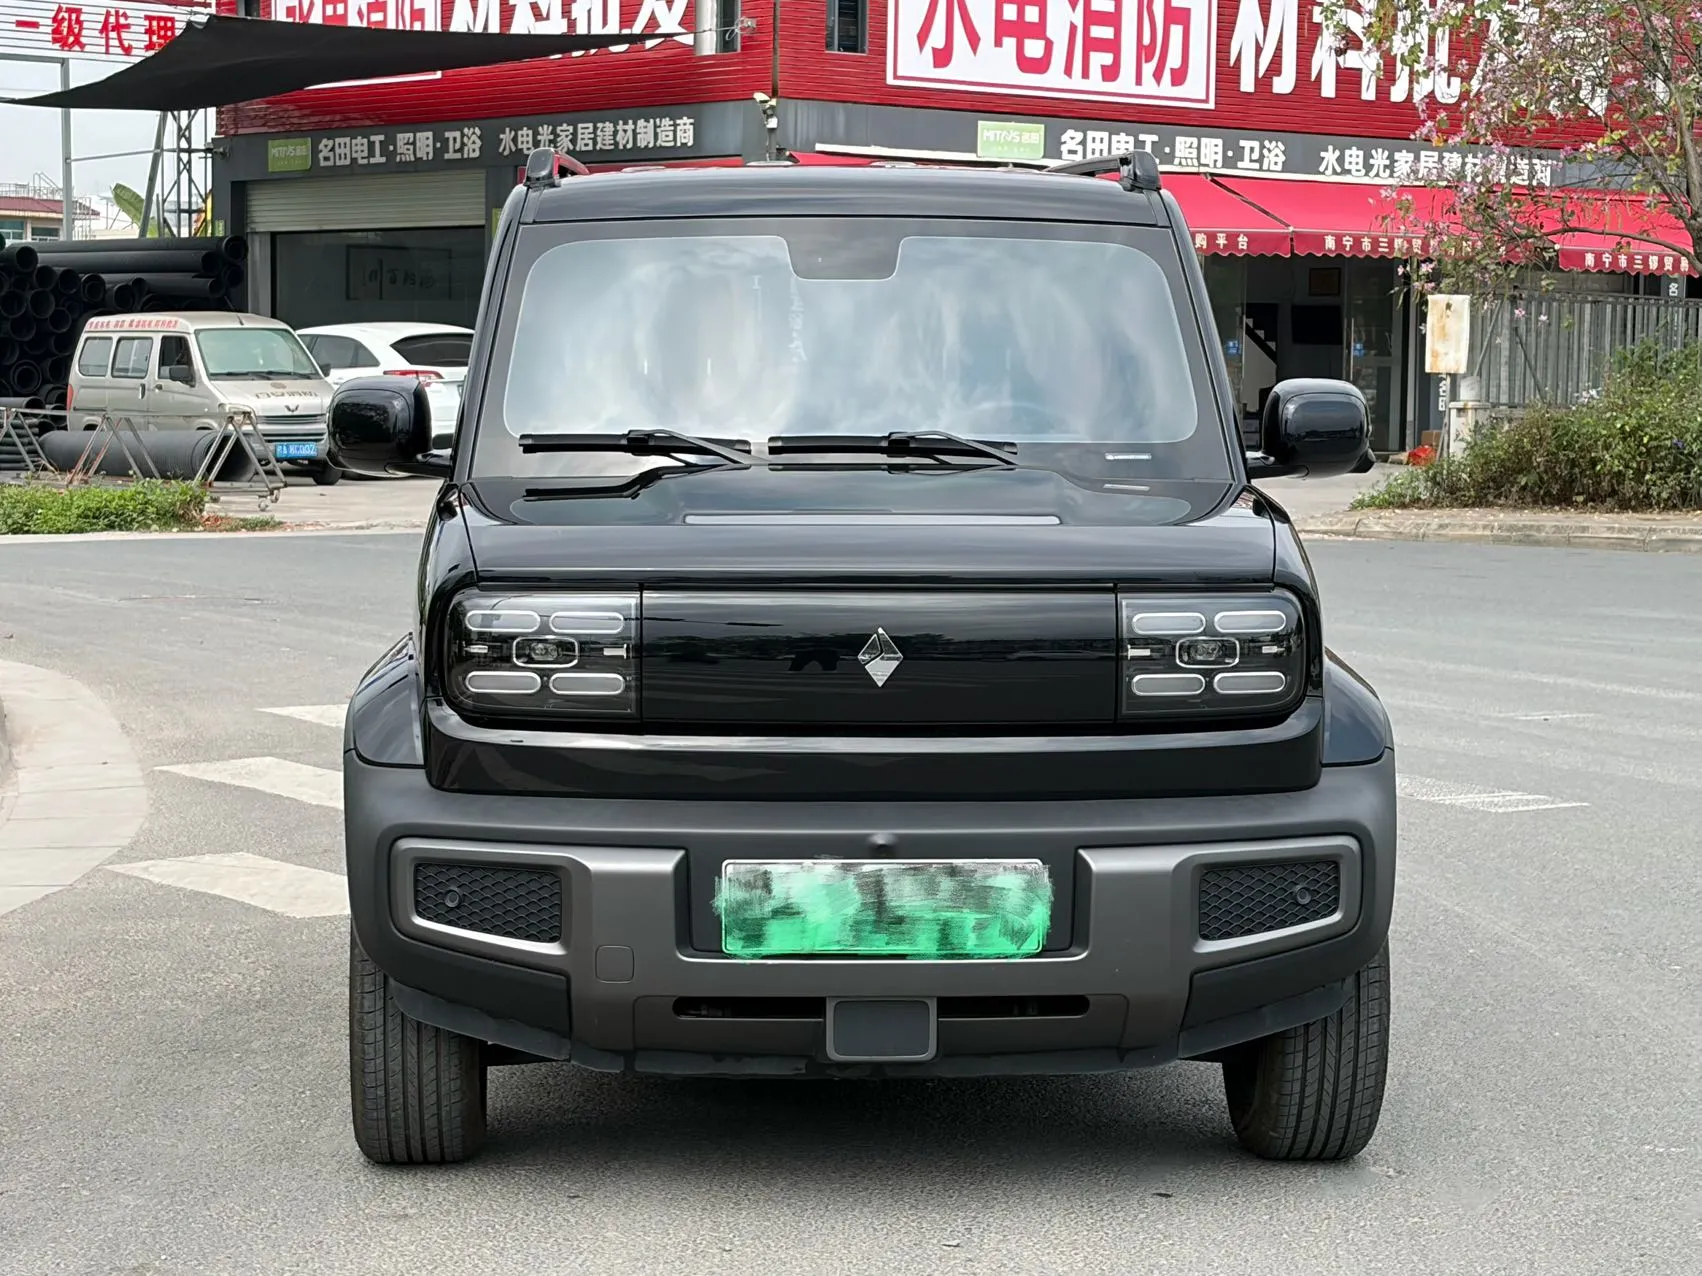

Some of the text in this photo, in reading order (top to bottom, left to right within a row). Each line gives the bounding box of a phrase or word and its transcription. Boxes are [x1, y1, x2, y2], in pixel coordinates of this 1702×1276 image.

[15, 4, 176, 55] 一级代理
[318, 127, 482, 167] 名田电工·照明·卫浴
[499, 117, 694, 156] 水电光家居建材制造商
[1195, 233, 1249, 250] 购平台
